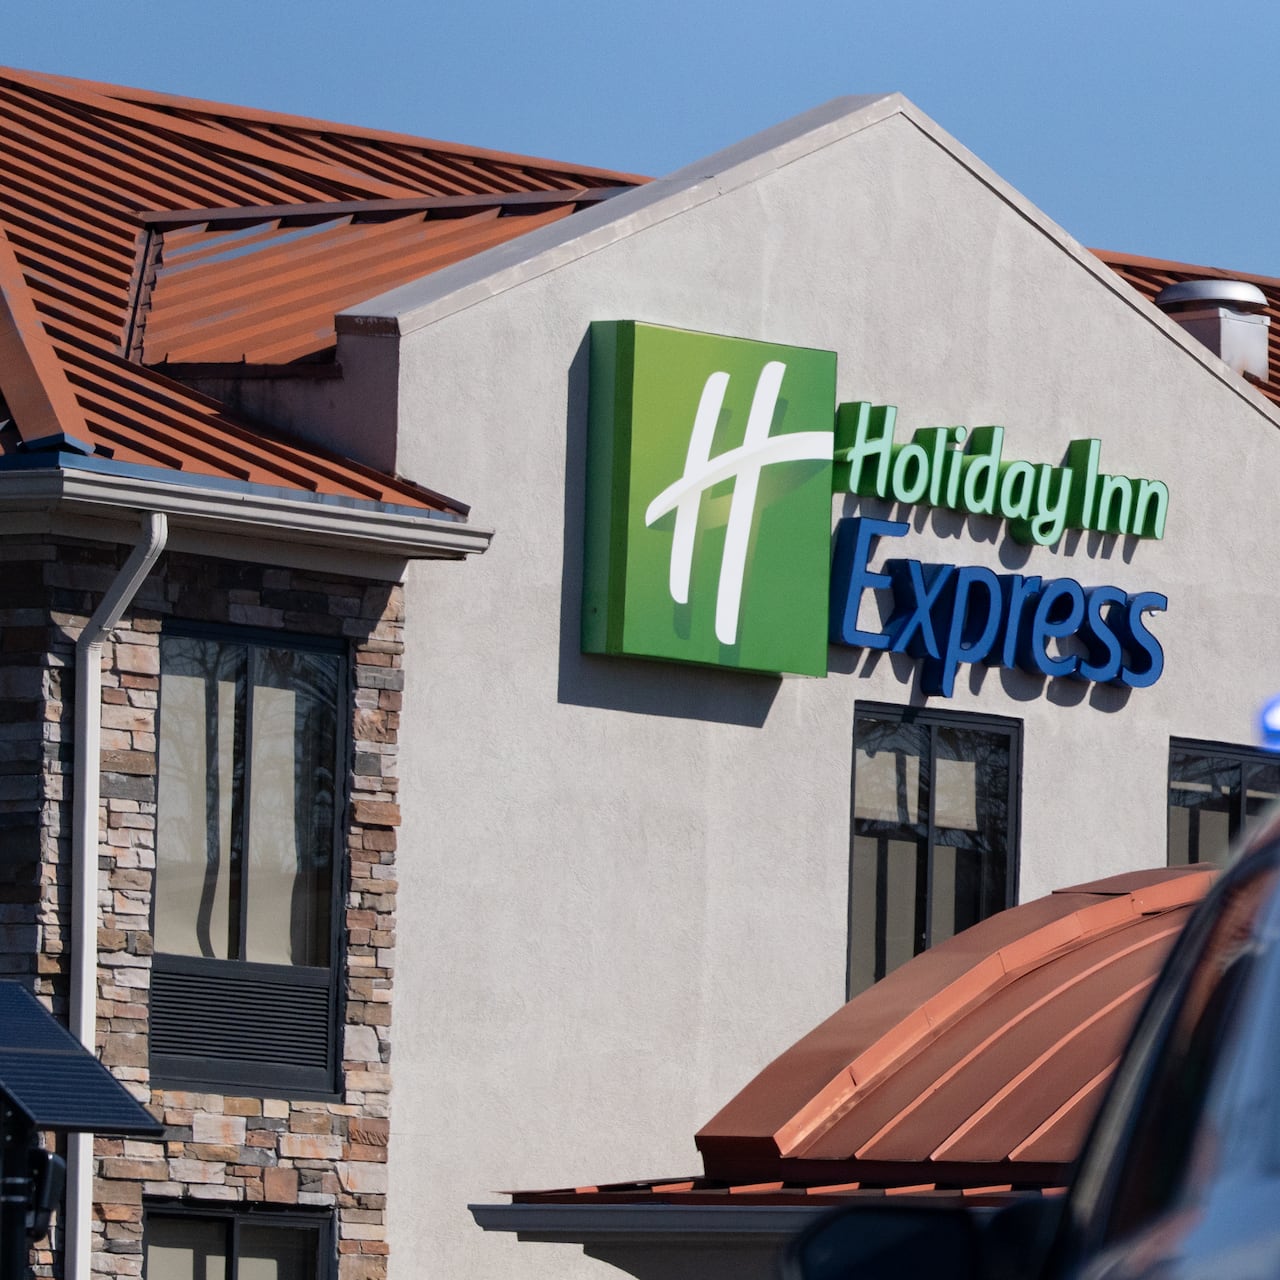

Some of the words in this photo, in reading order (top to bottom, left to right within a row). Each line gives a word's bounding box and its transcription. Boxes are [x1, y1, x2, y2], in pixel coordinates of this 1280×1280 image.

[838, 401, 1072, 546] Holiday
[1074, 438, 1169, 540] Inn
[834, 516, 1168, 698] Express
